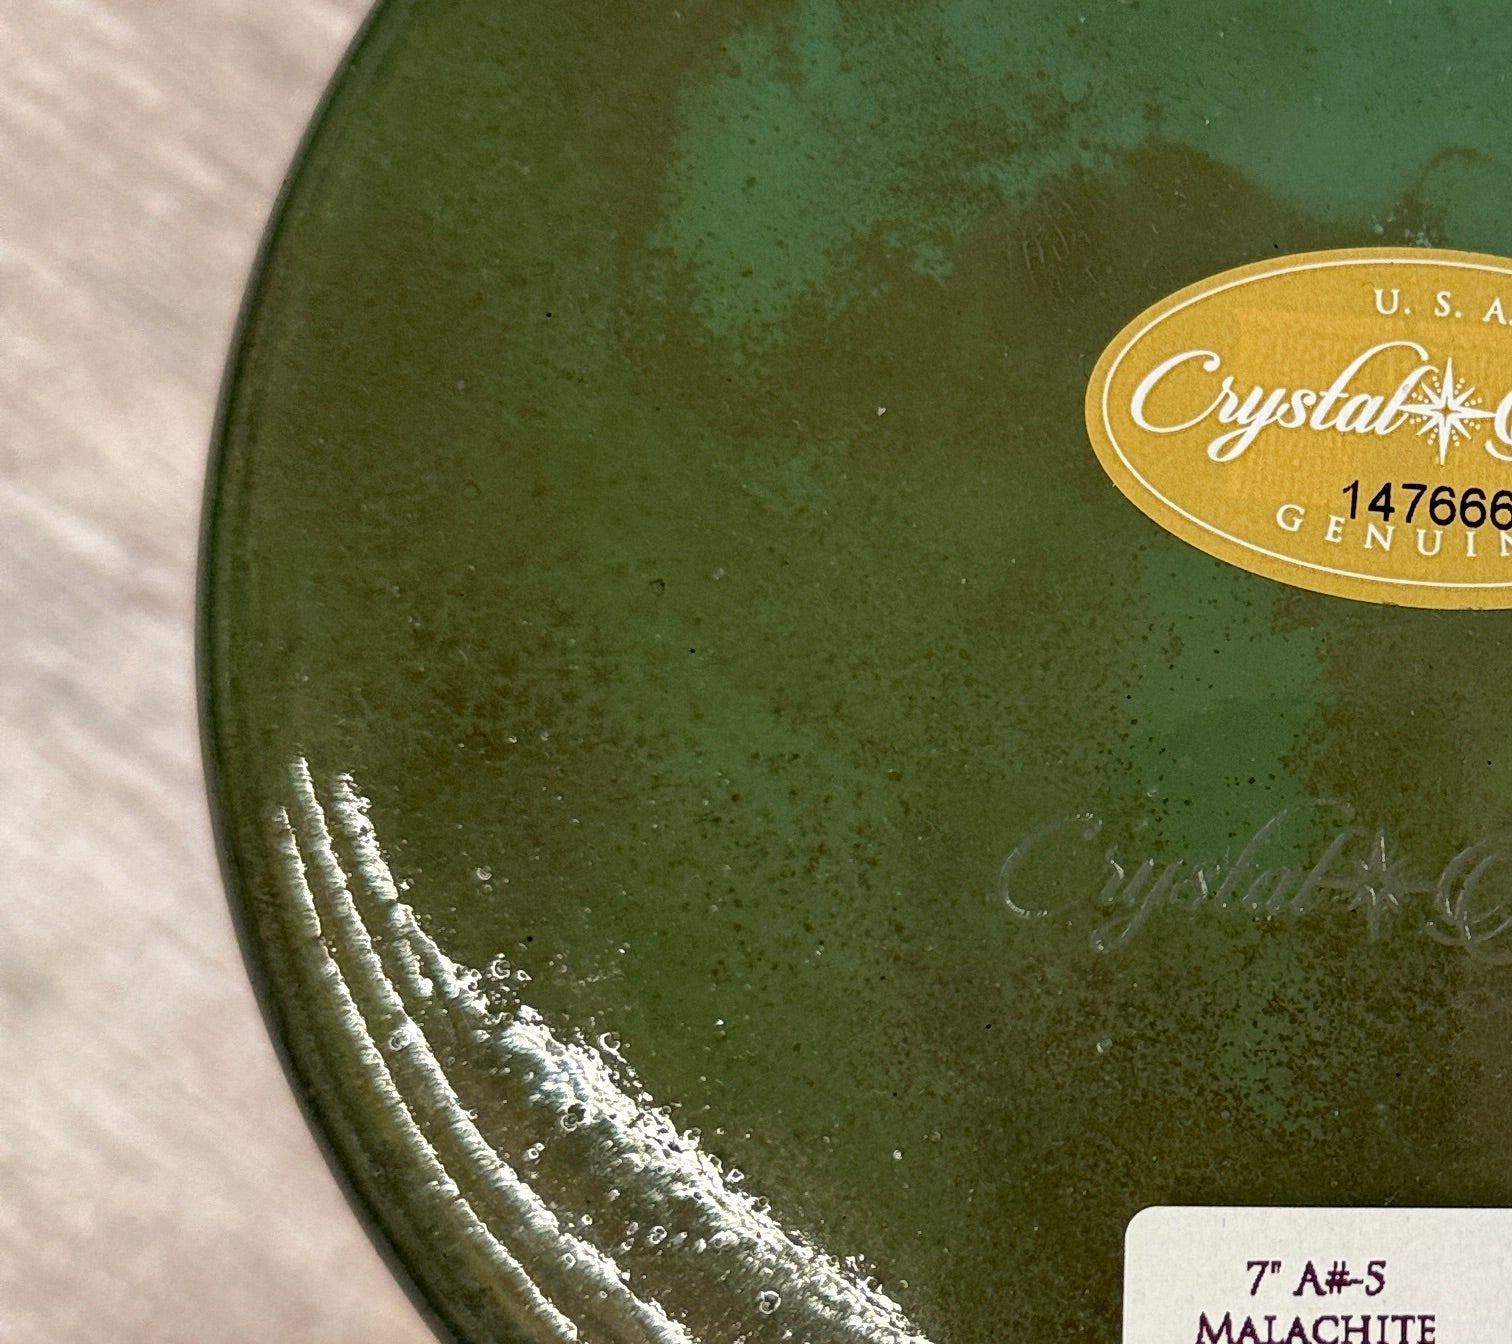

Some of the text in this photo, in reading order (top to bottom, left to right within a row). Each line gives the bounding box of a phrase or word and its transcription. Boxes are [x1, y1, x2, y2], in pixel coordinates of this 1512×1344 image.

[1130, 340, 1438, 463] Crystal
[1246, 1260, 1388, 1296] 7" A#-5
